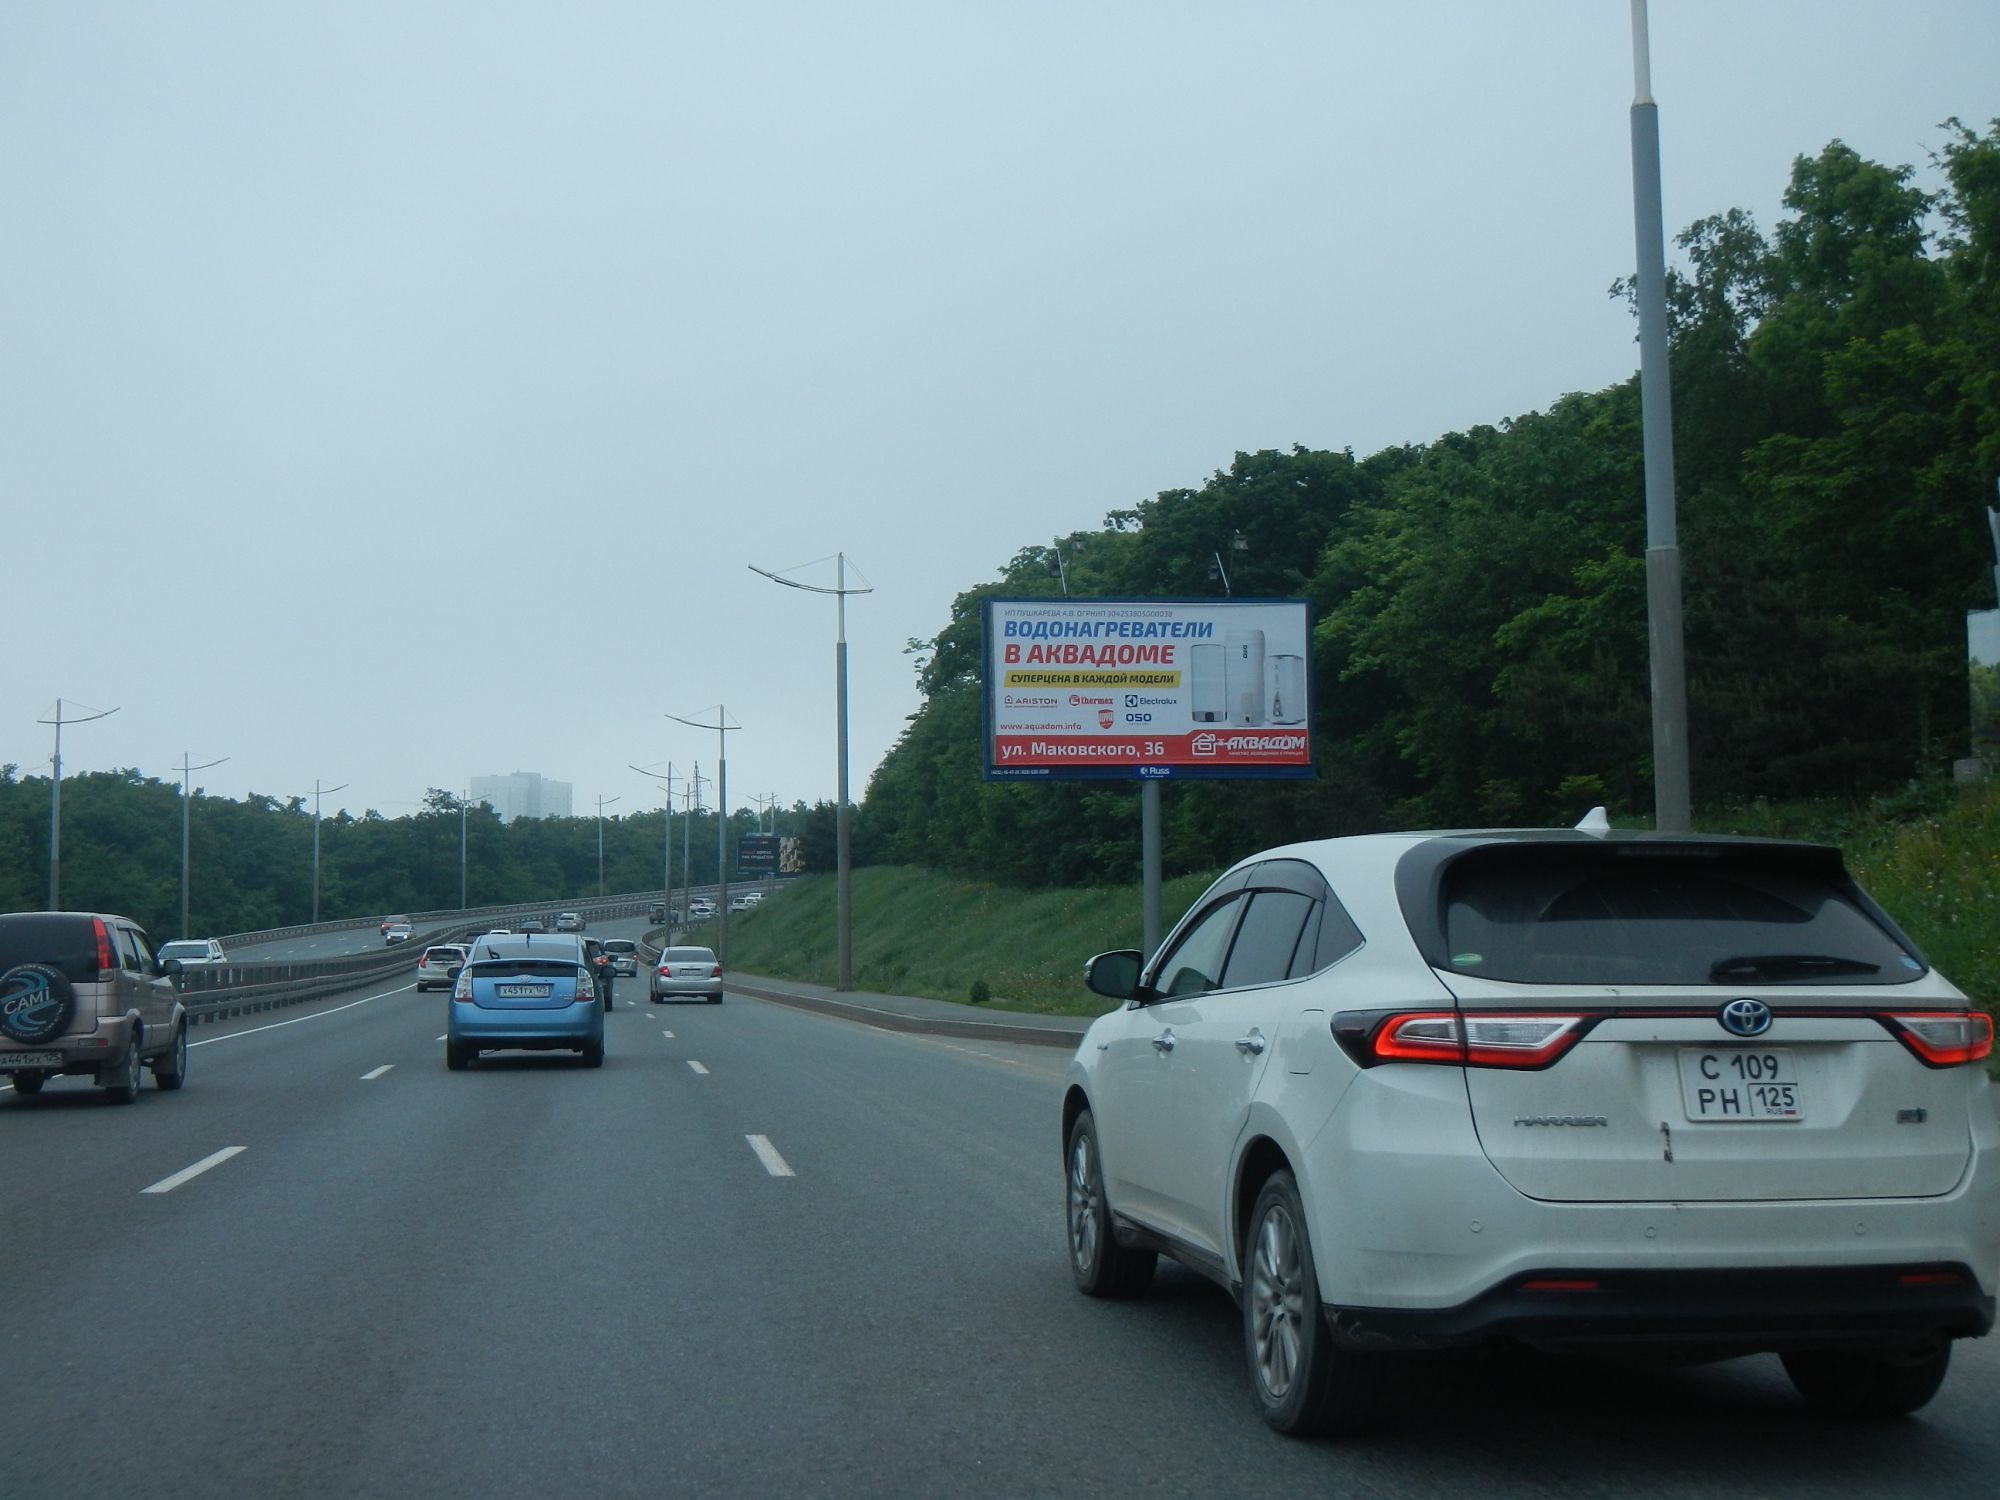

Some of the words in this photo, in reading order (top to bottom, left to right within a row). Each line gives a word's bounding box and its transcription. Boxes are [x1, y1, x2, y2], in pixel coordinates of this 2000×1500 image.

[1004, 620, 1213, 640] ВОДОНАГРЕВАТЕЛИ
[1004, 643, 1021, 664] В
[1026, 644, 1176, 667] АКВАДОМЕ
[1011, 674, 1071, 685] СУПЕРЦЕНА
[1072, 674, 1081, 683] В
[1081, 673, 1128, 685] КАЖДОЙ
[1129, 674, 1174, 685] МОДЕЛИ
[1015, 697, 1058, 705] ARISTON
[1081, 695, 1114, 705] thermex
[1139, 697, 1177, 705] Electrolux
[1000, 722, 1082, 732] www.aquadom.info
[1226, 735, 1306, 751] АКВАДОМ
[1002, 745, 1027, 759] ул.
[1031, 741, 1140, 758] Маковского,
[1144, 741, 1165, 756] 36
[1149, 766, 1170, 775] Russ
[1730, 1054, 1778, 1080] 109
[1755, 1086, 1795, 1107] 125
[1765, 1107, 1784, 1115] RUS
